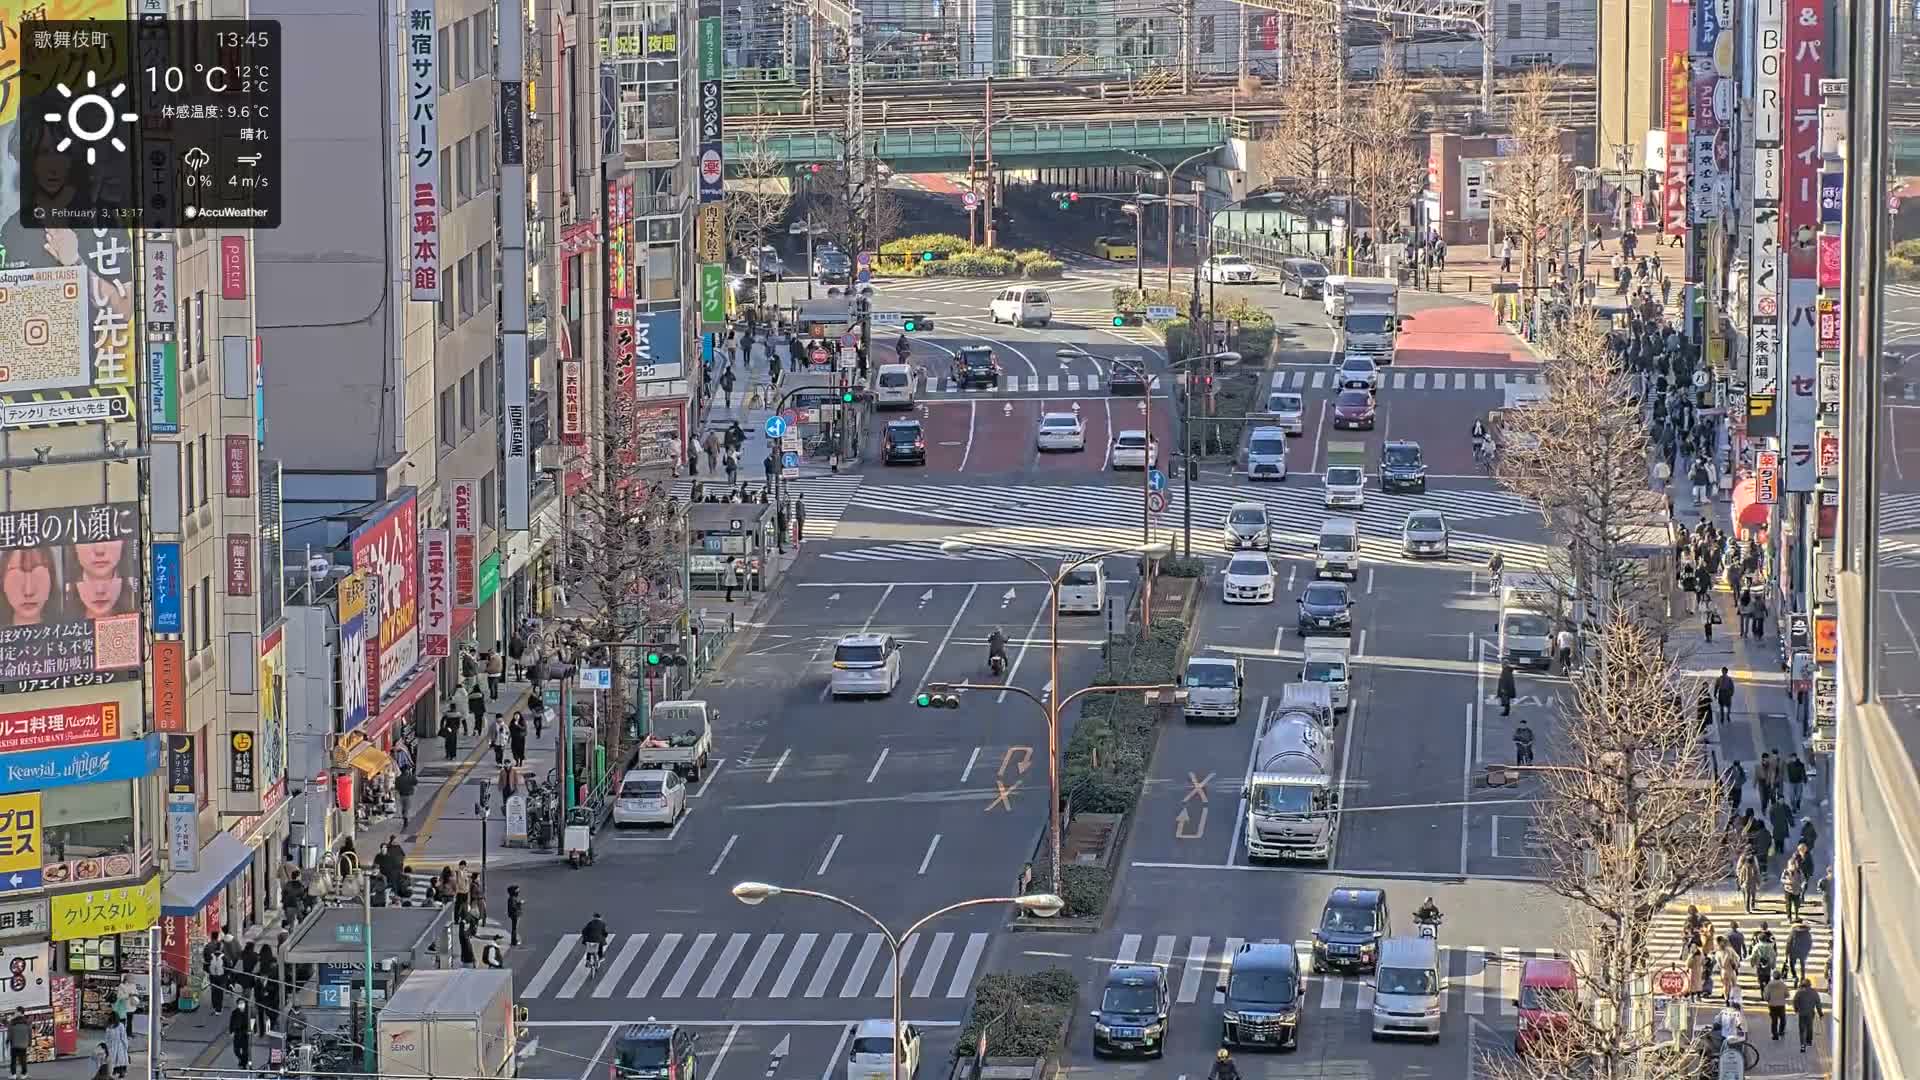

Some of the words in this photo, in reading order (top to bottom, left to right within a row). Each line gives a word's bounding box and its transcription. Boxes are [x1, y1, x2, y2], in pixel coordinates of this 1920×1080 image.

[411, 9, 434, 168] 新宿サンパーク
[414, 183, 436, 289] 三平本館
[706, 273, 719, 313] レイク
[1755, 327, 1769, 380] 大衆酒場
[152, 351, 163, 412] FamilyMart
[1791, 305, 1816, 467] パセラ
[9, 408, 43, 420] テンクリ
[49, 403, 107, 417] たいせい先生
[456, 485, 467, 529] GAME
[428, 540, 445, 627] 三平ストア
[18, 672, 115, 693] リアエイドビジョン
[20, 734, 64, 745] RESTAURANT
[64, 903, 137, 926] クリスタル
[323, 989, 337, 1002] 12
[391, 1043, 415, 1052] SEINO
